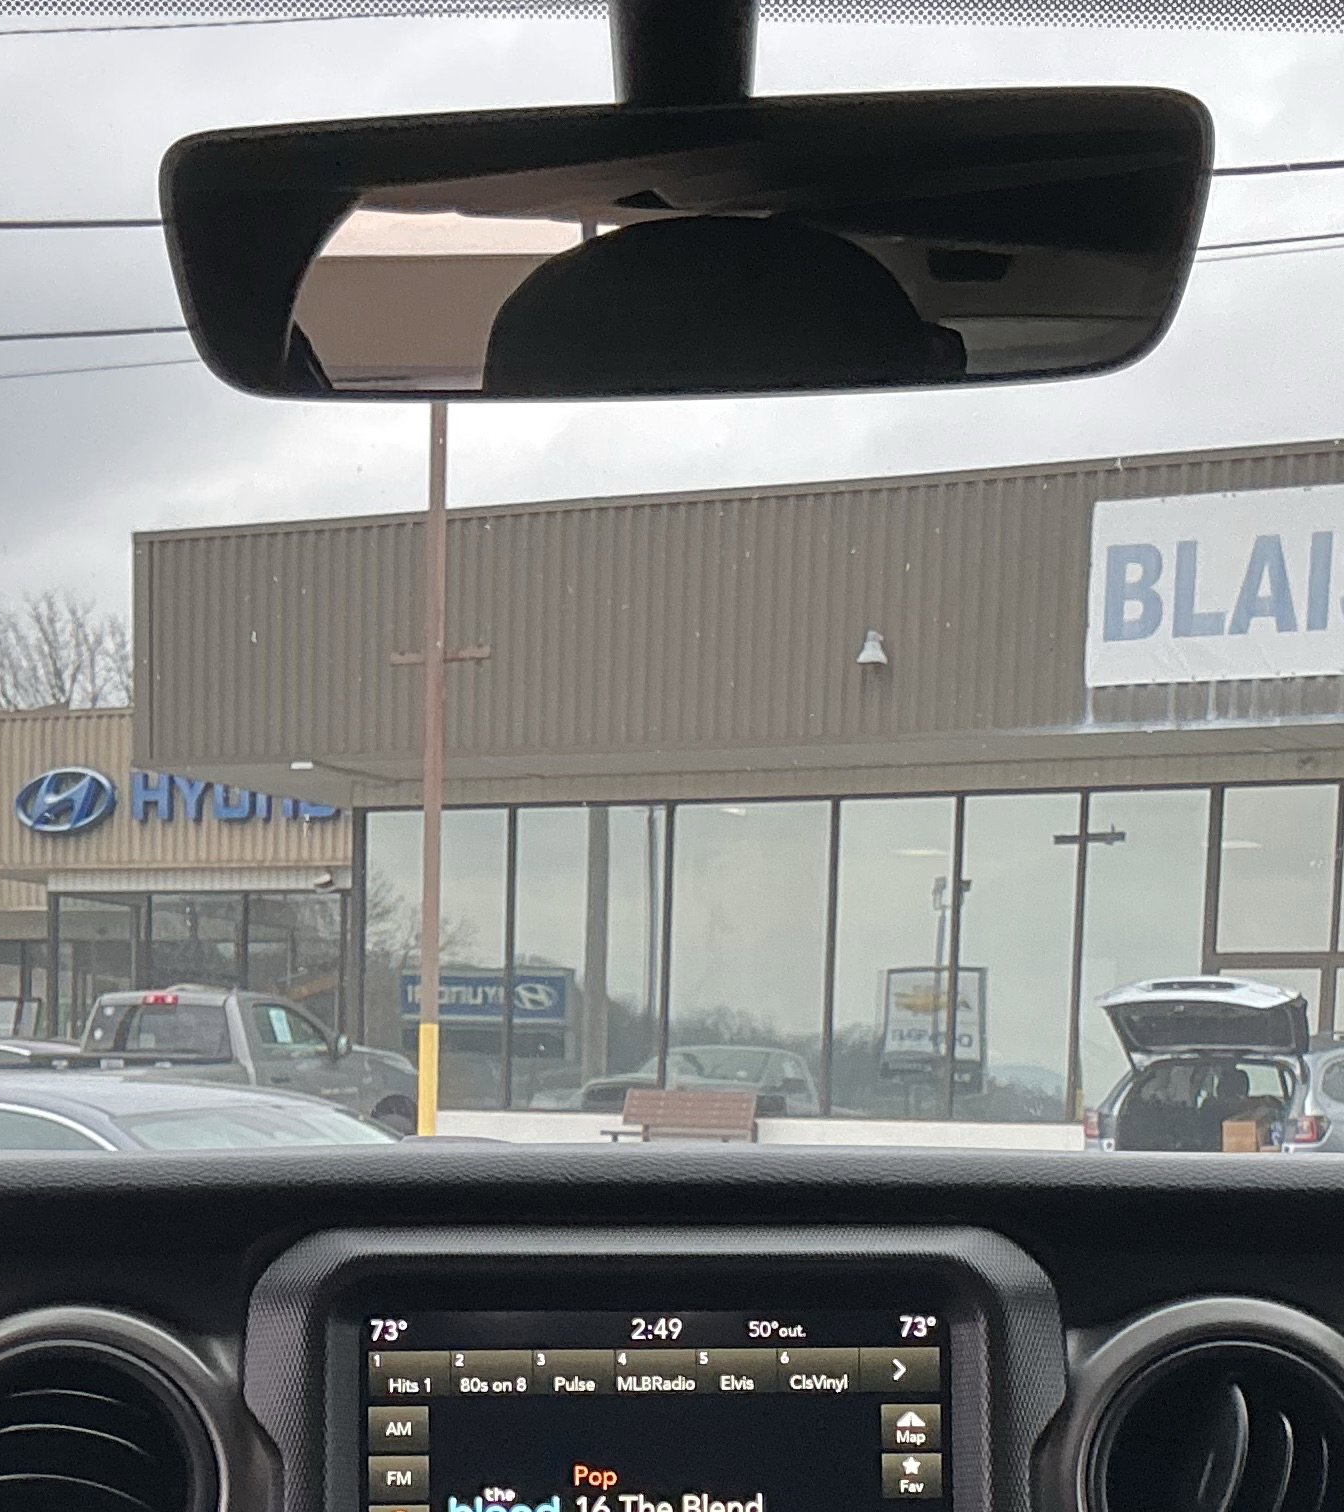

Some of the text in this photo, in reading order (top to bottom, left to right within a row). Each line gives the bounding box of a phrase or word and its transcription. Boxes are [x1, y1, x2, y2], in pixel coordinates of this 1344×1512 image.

[631, 1318, 682, 1341] 2:49
[373, 1355, 381, 1368] 1
[455, 1354, 464, 1368] 2
[536, 1353, 545, 1367] 3
[617, 1352, 627, 1366] 4
[699, 1352, 708, 1365] 5
[780, 1351, 789, 1365] 6
[389, 1377, 432, 1392] Hits 1
[460, 1377, 527, 1392] 80s on 8
[554, 1377, 595, 1392] Pulse
[617, 1376, 696, 1391] MLBRadio
[720, 1376, 754, 1391] Elvis
[790, 1375, 849, 1392] ClsVinyl
[385, 1422, 412, 1436] AM
[896, 1430, 926, 1446] Map
[387, 1471, 412, 1486] FM
[573, 1465, 618, 1488] Pop
[484, 1487, 516, 1502] the
[899, 1480, 924, 1494] Fav
